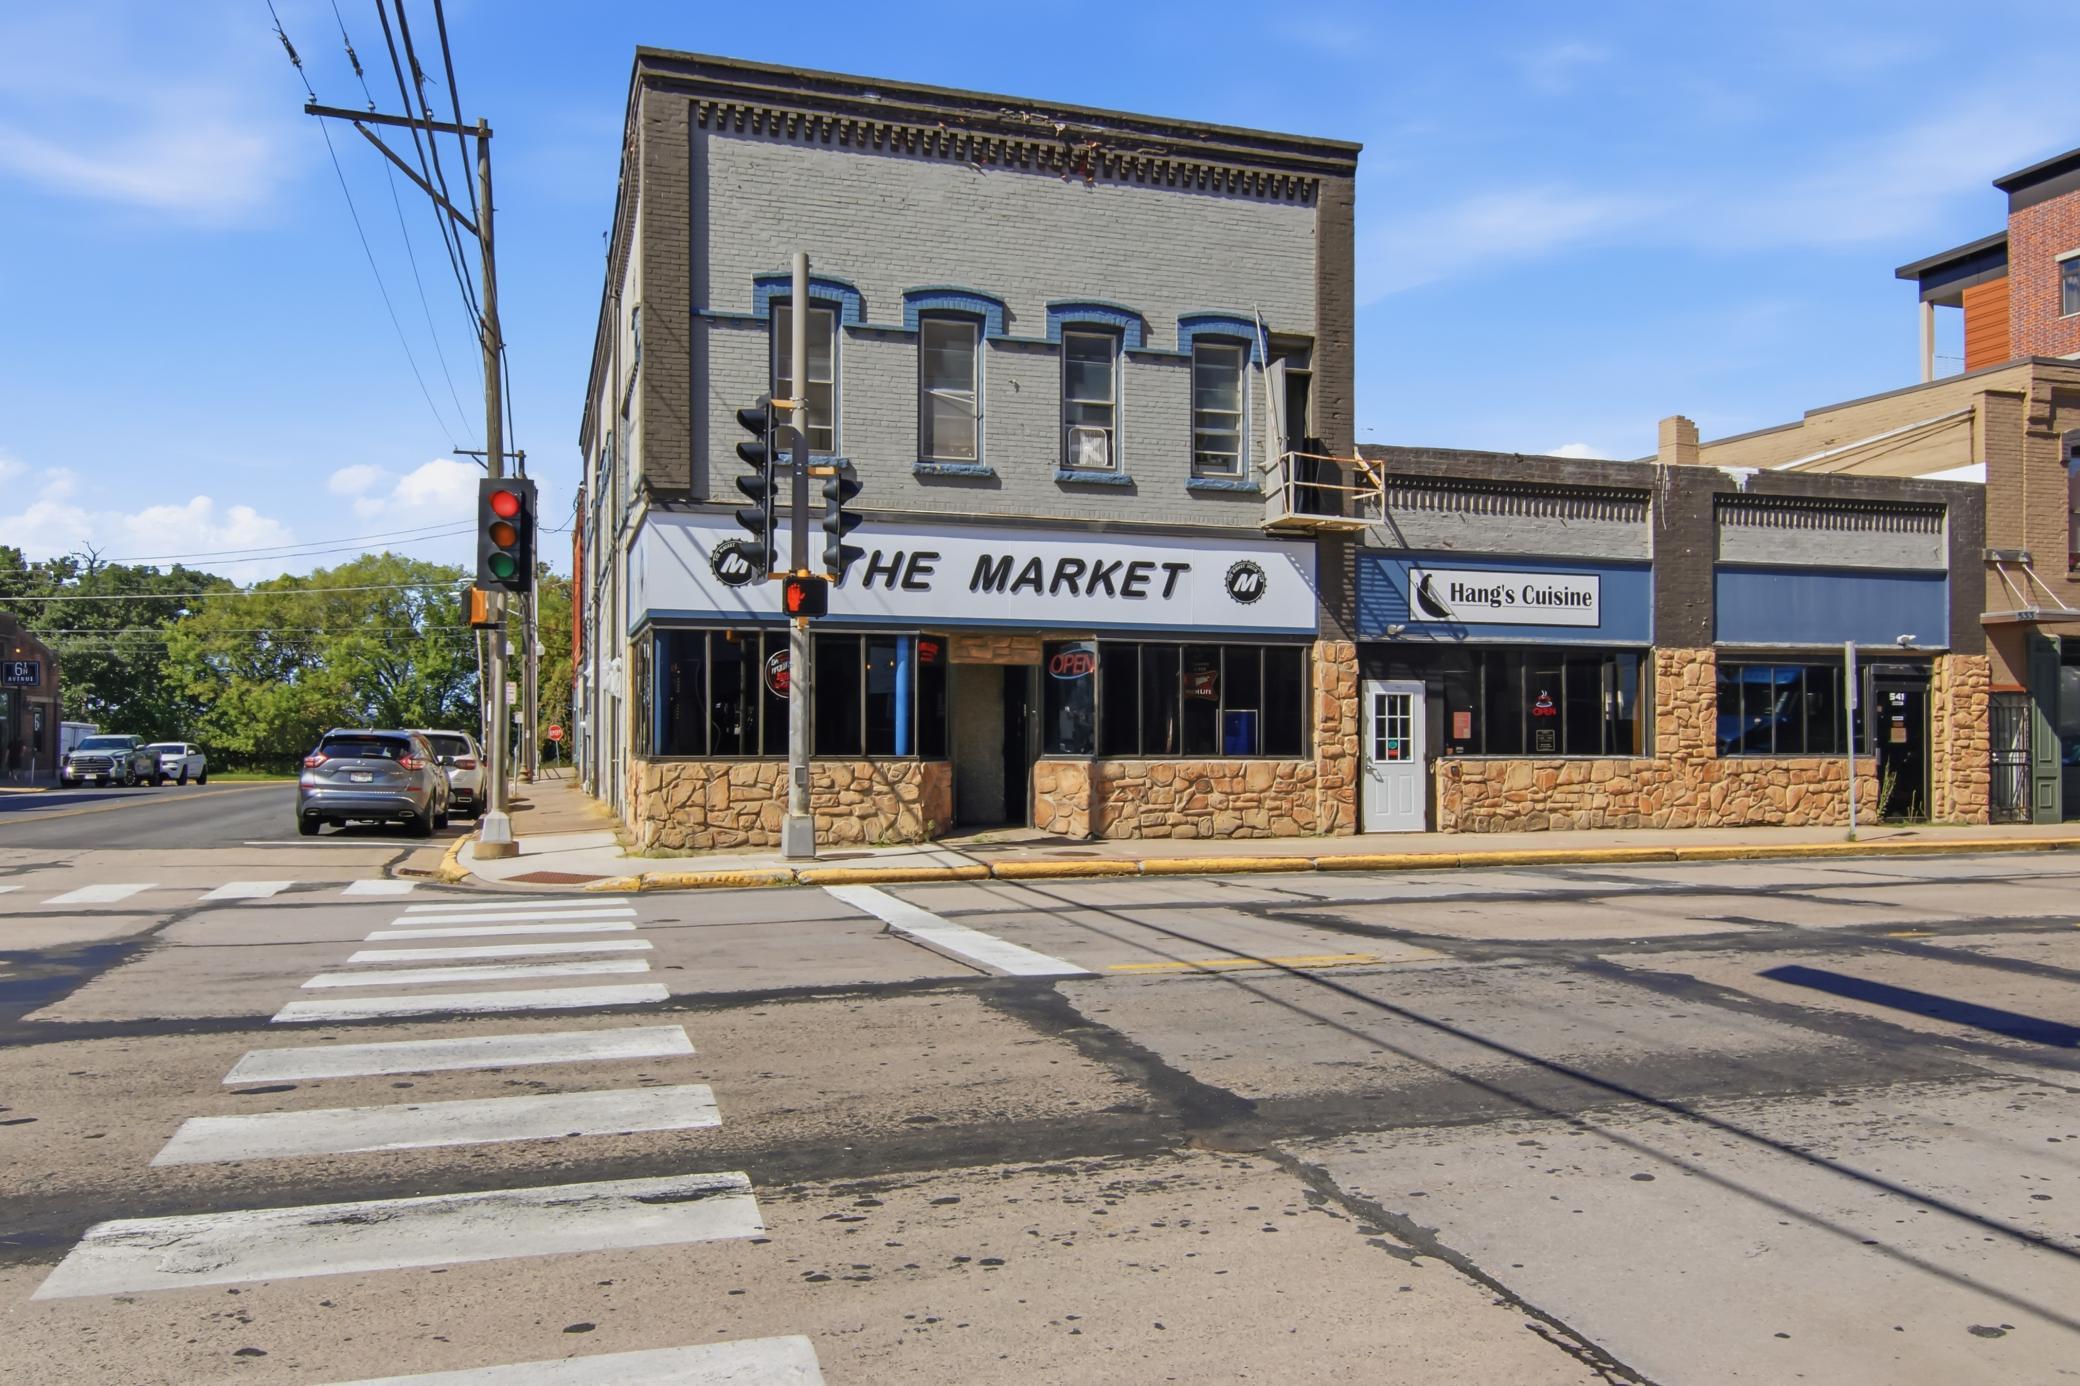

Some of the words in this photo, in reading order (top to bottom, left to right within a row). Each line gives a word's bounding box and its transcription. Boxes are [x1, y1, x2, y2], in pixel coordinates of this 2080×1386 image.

[720, 552, 749, 574] M
[837, 549, 941, 590] HE
[969, 553, 1192, 600] MARKET
[1233, 573, 1259, 592] M
[1450, 582, 1516, 608] Hang's
[1521, 584, 1593, 608] Cuisine
[1049, 653, 1096, 675] OPEN
[1889, 692, 1905, 701] 541
